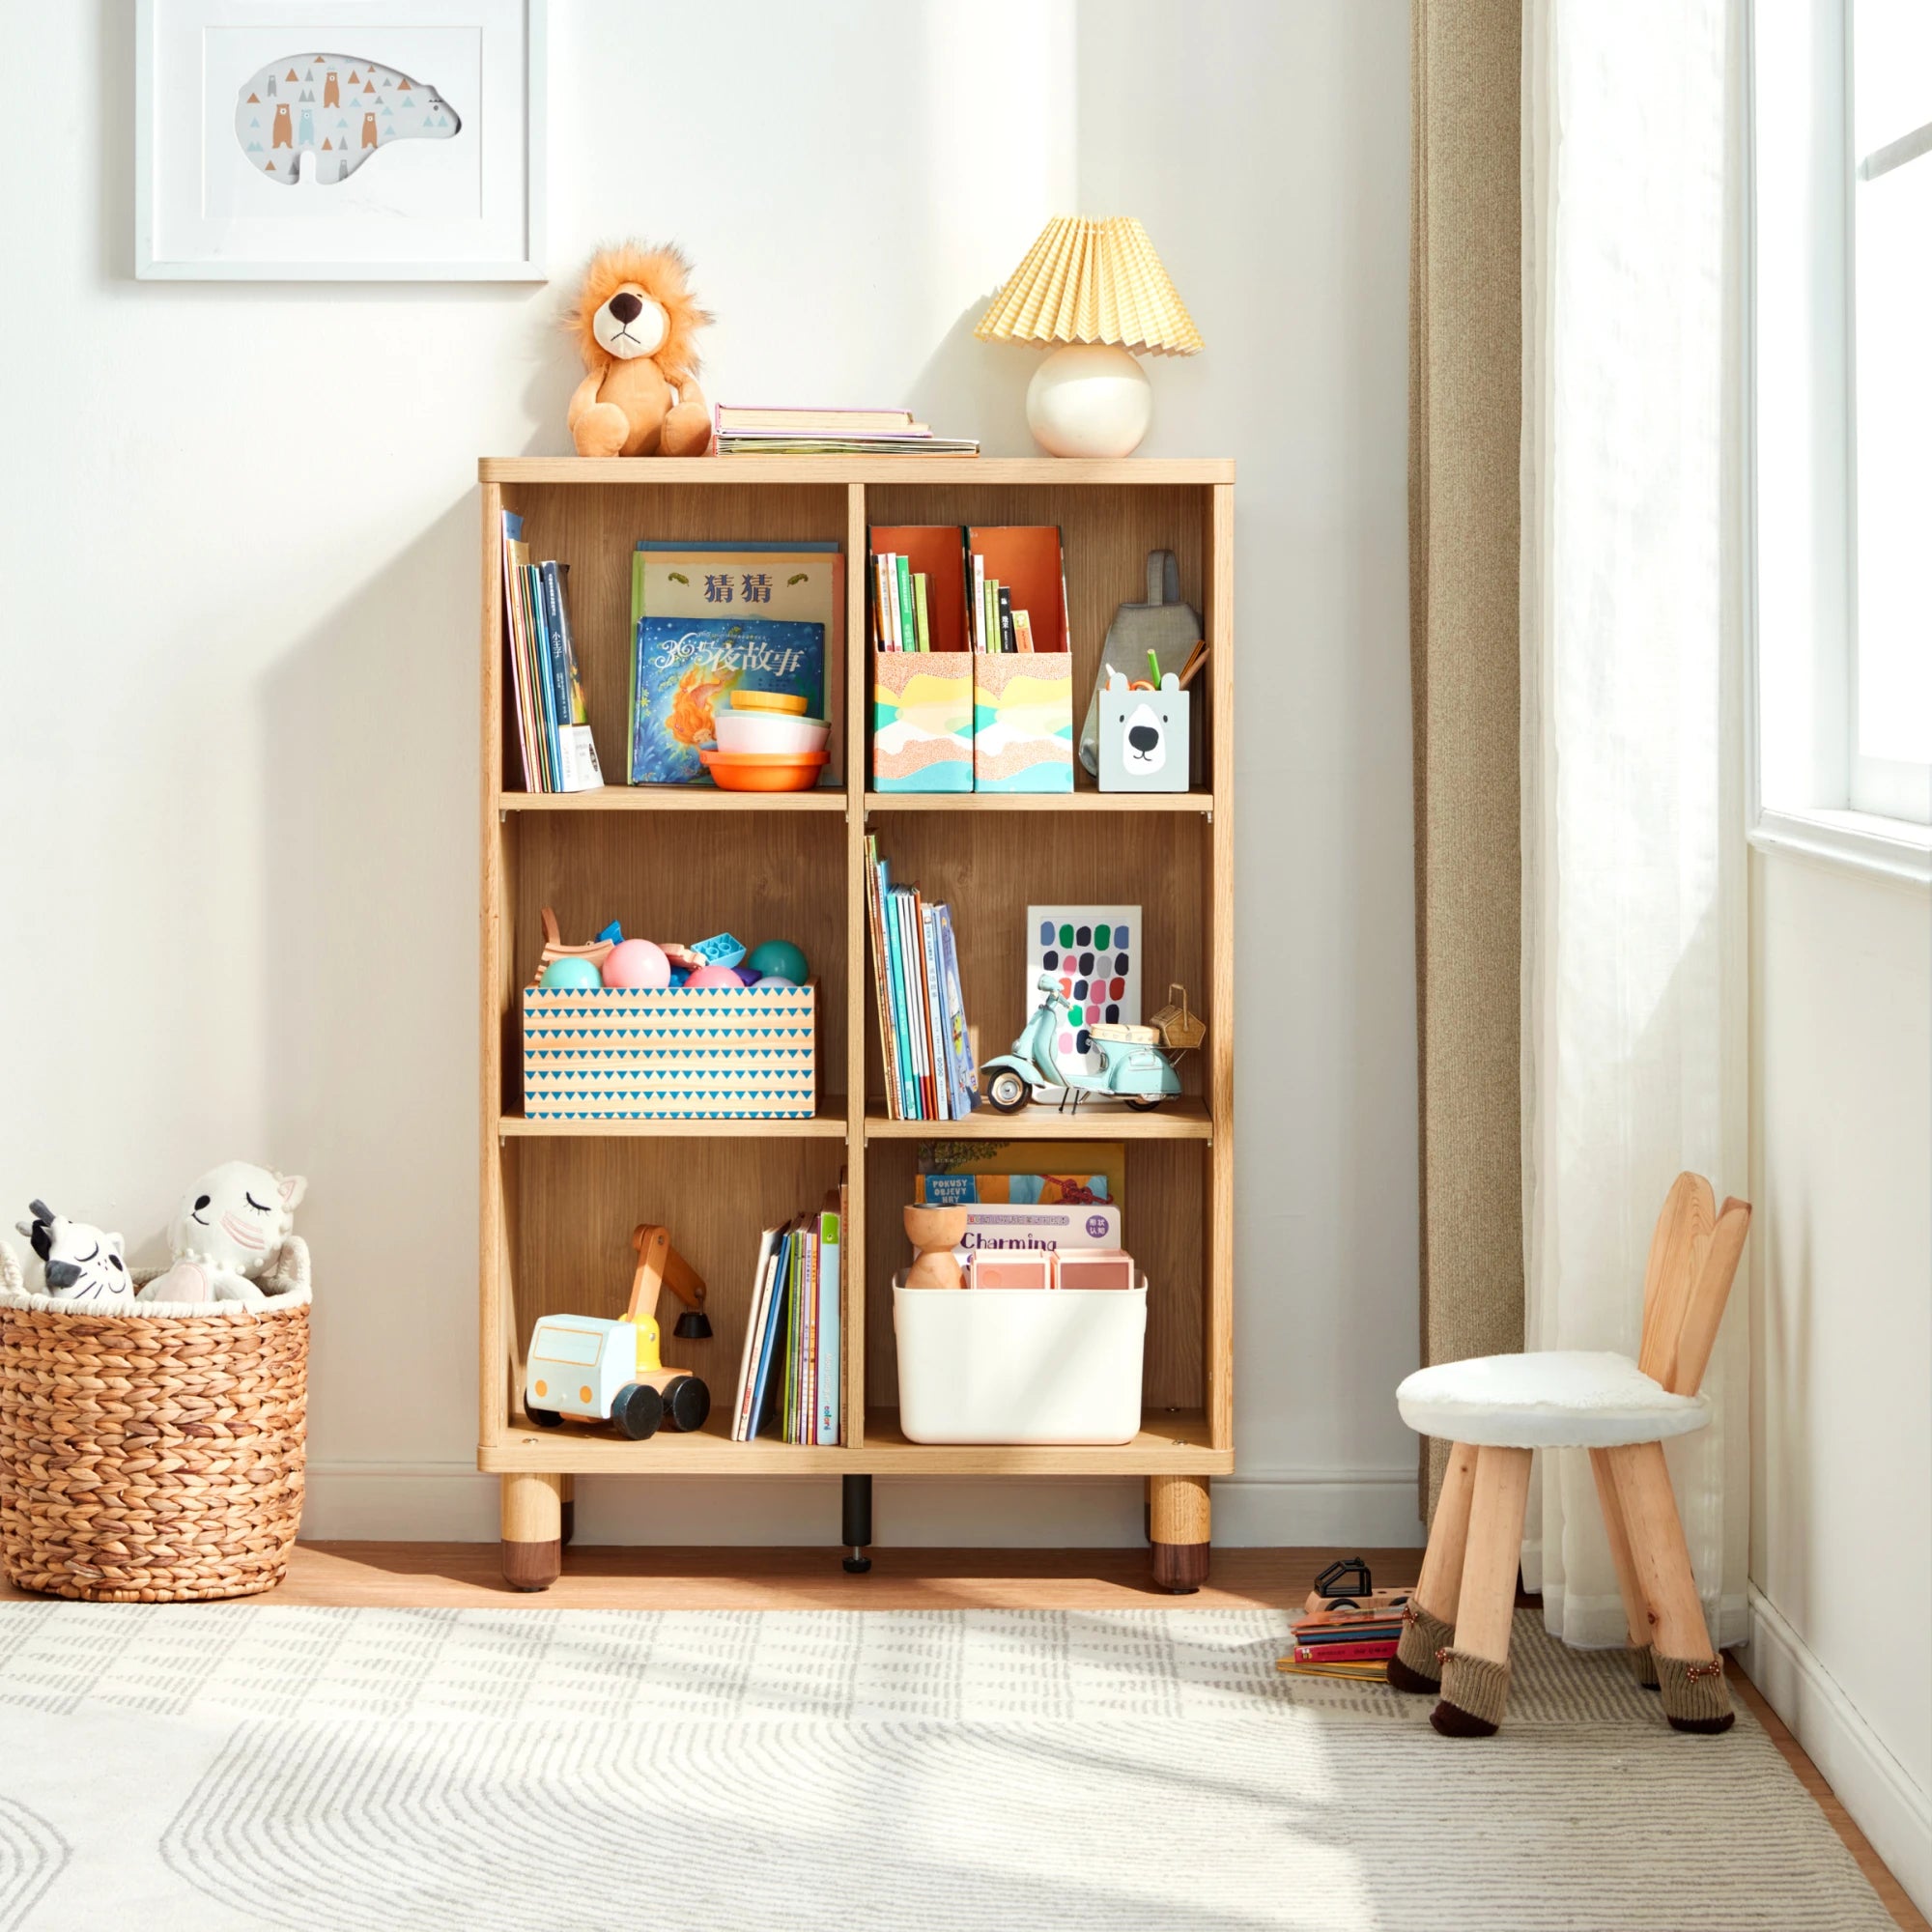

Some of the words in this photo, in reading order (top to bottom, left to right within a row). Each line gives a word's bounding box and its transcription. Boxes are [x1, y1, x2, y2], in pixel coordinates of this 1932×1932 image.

[703, 573, 774, 604] 猜猜
[552, 631, 562, 659] 小王子
[654, 631, 805, 677] 365夜故事
[932, 1179, 968, 1188] POKUSY
[934, 1187, 967, 1196] OBJEVY
[960, 1232, 1057, 1253] Charming
